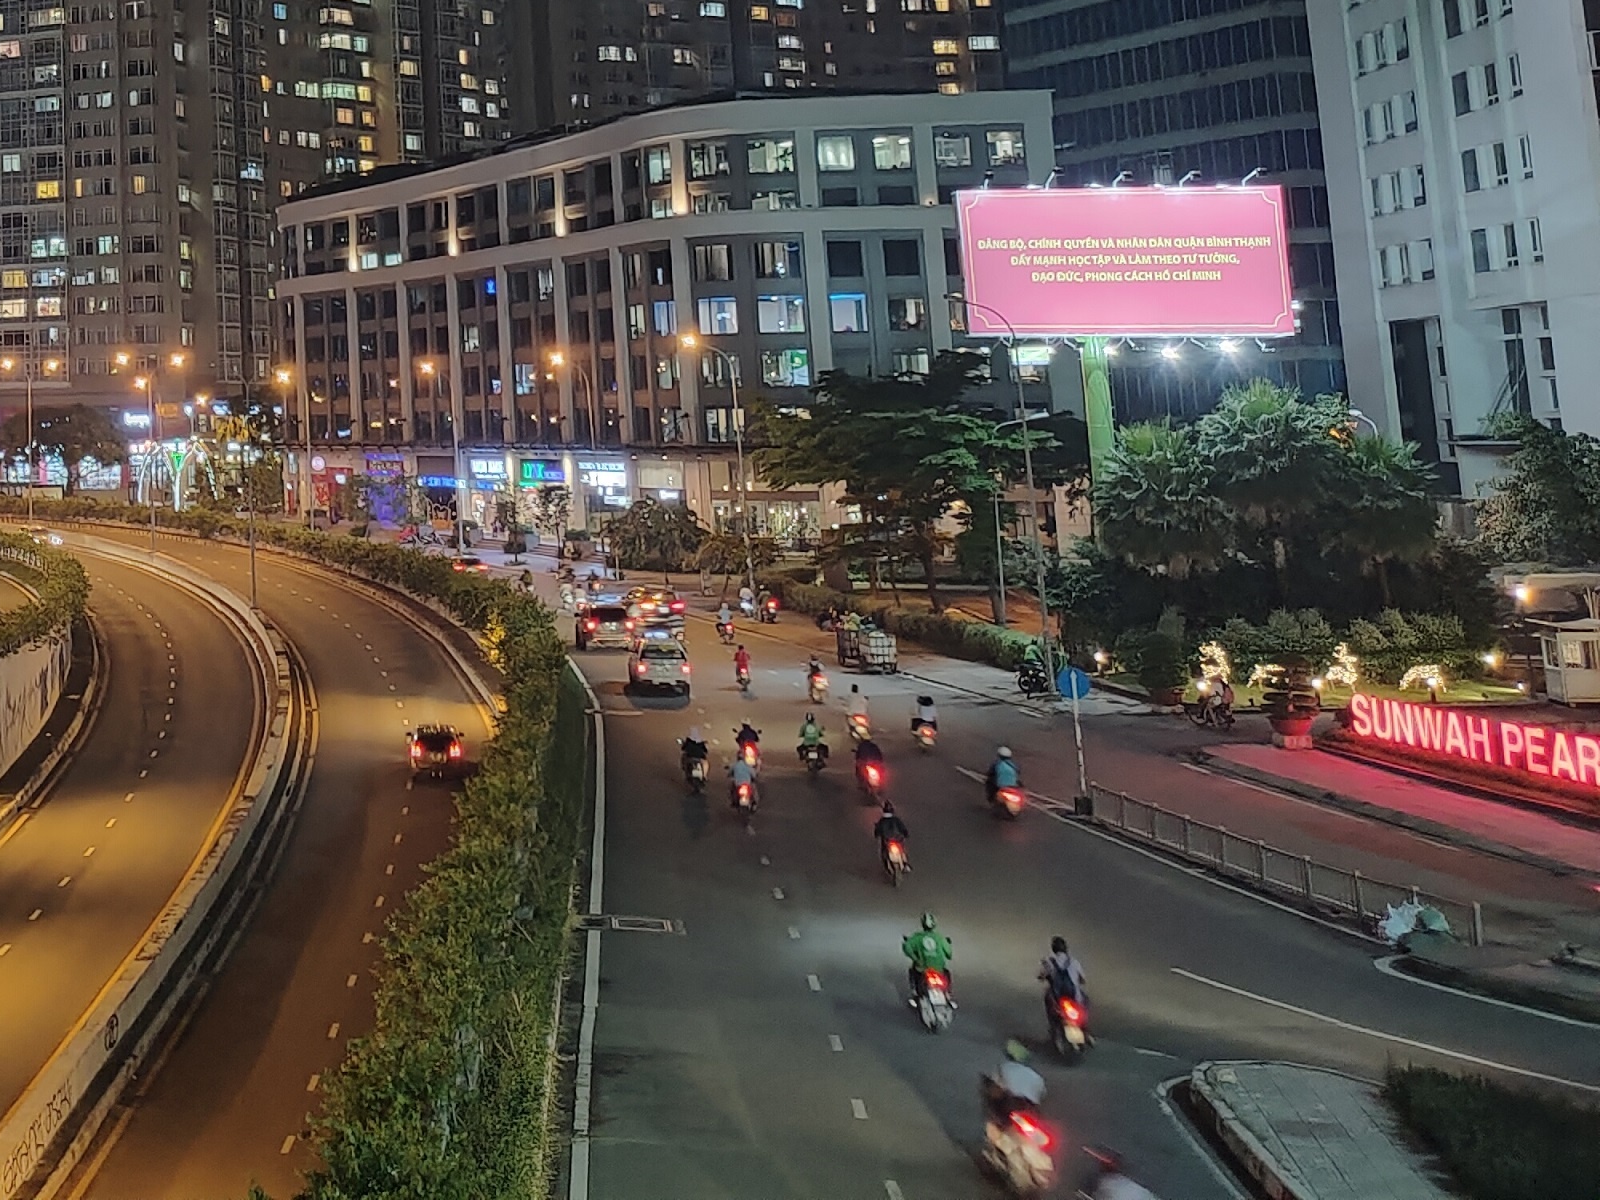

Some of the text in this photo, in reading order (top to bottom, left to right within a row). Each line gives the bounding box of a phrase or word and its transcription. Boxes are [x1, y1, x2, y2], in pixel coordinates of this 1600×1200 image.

[1028, 237, 1061, 249] CHÍNH
[1232, 236, 1271, 249] THẠNH
[1033, 255, 1067, 268] MẠNH
[1068, 255, 1091, 268] HỌC
[1152, 254, 1181, 264] THEO
[1085, 271, 1122, 282] PHONG
[1124, 270, 1153, 282] CÁCH
[1192, 270, 1221, 280] MINH
[1351, 692, 1600, 787] SUNWAH PEAR
